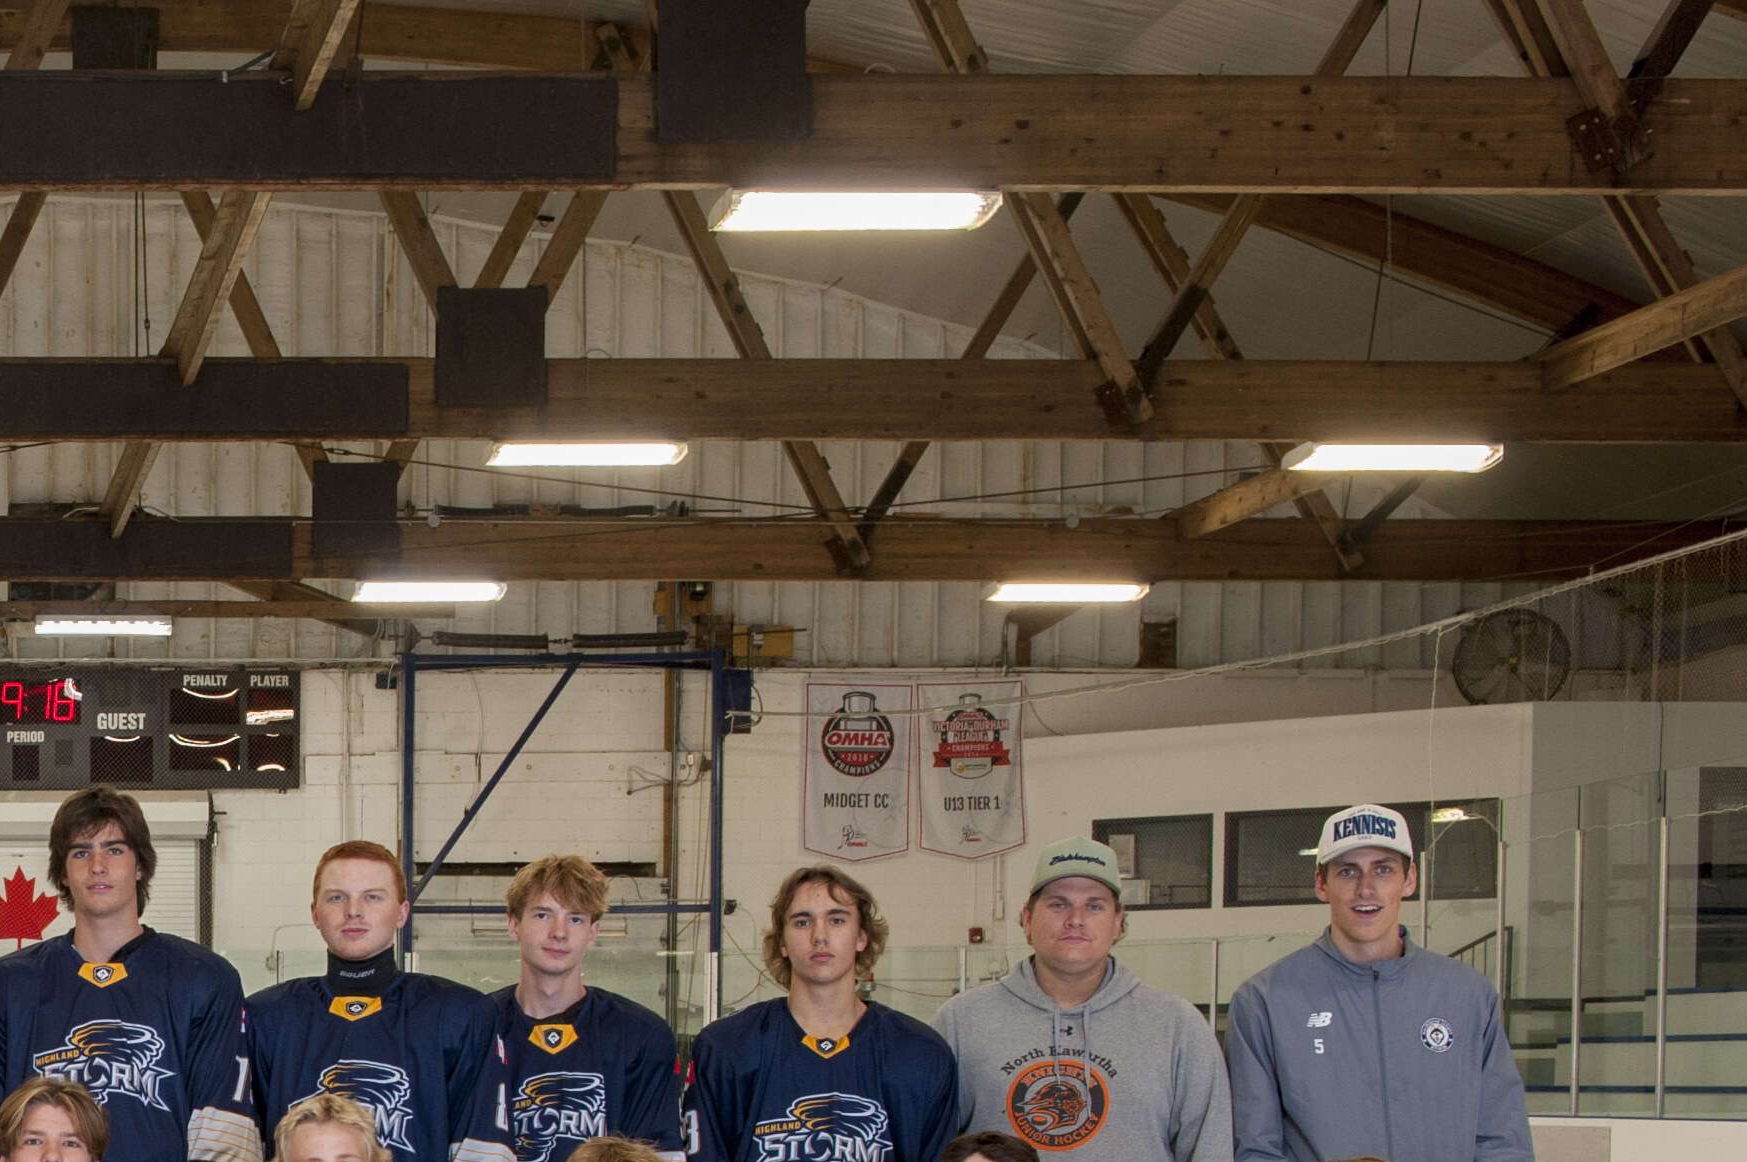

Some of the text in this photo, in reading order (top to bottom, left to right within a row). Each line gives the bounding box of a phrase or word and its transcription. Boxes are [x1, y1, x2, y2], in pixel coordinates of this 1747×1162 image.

[183, 674, 289, 688] PENALTY PLAYER
[97, 712, 146, 732] GUEST
[6, 730, 44, 744] PERIOD
[827, 732, 887, 746] OMHA
[834, 759, 881, 775] CHAMPIONS
[823, 793, 889, 809] MIDGET CC
[944, 796, 1001, 811] U13 TIER 1
[1334, 814, 1397, 842] KENNISIS
[1314, 1039, 1325, 1054] 5
[34, 1048, 80, 1068] HIGHLAND
[1001, 1047, 1044, 1076] North
[754, 1118, 801, 1136] HIGHLAND
[1054, 1113, 1099, 1145] HOCKEY
